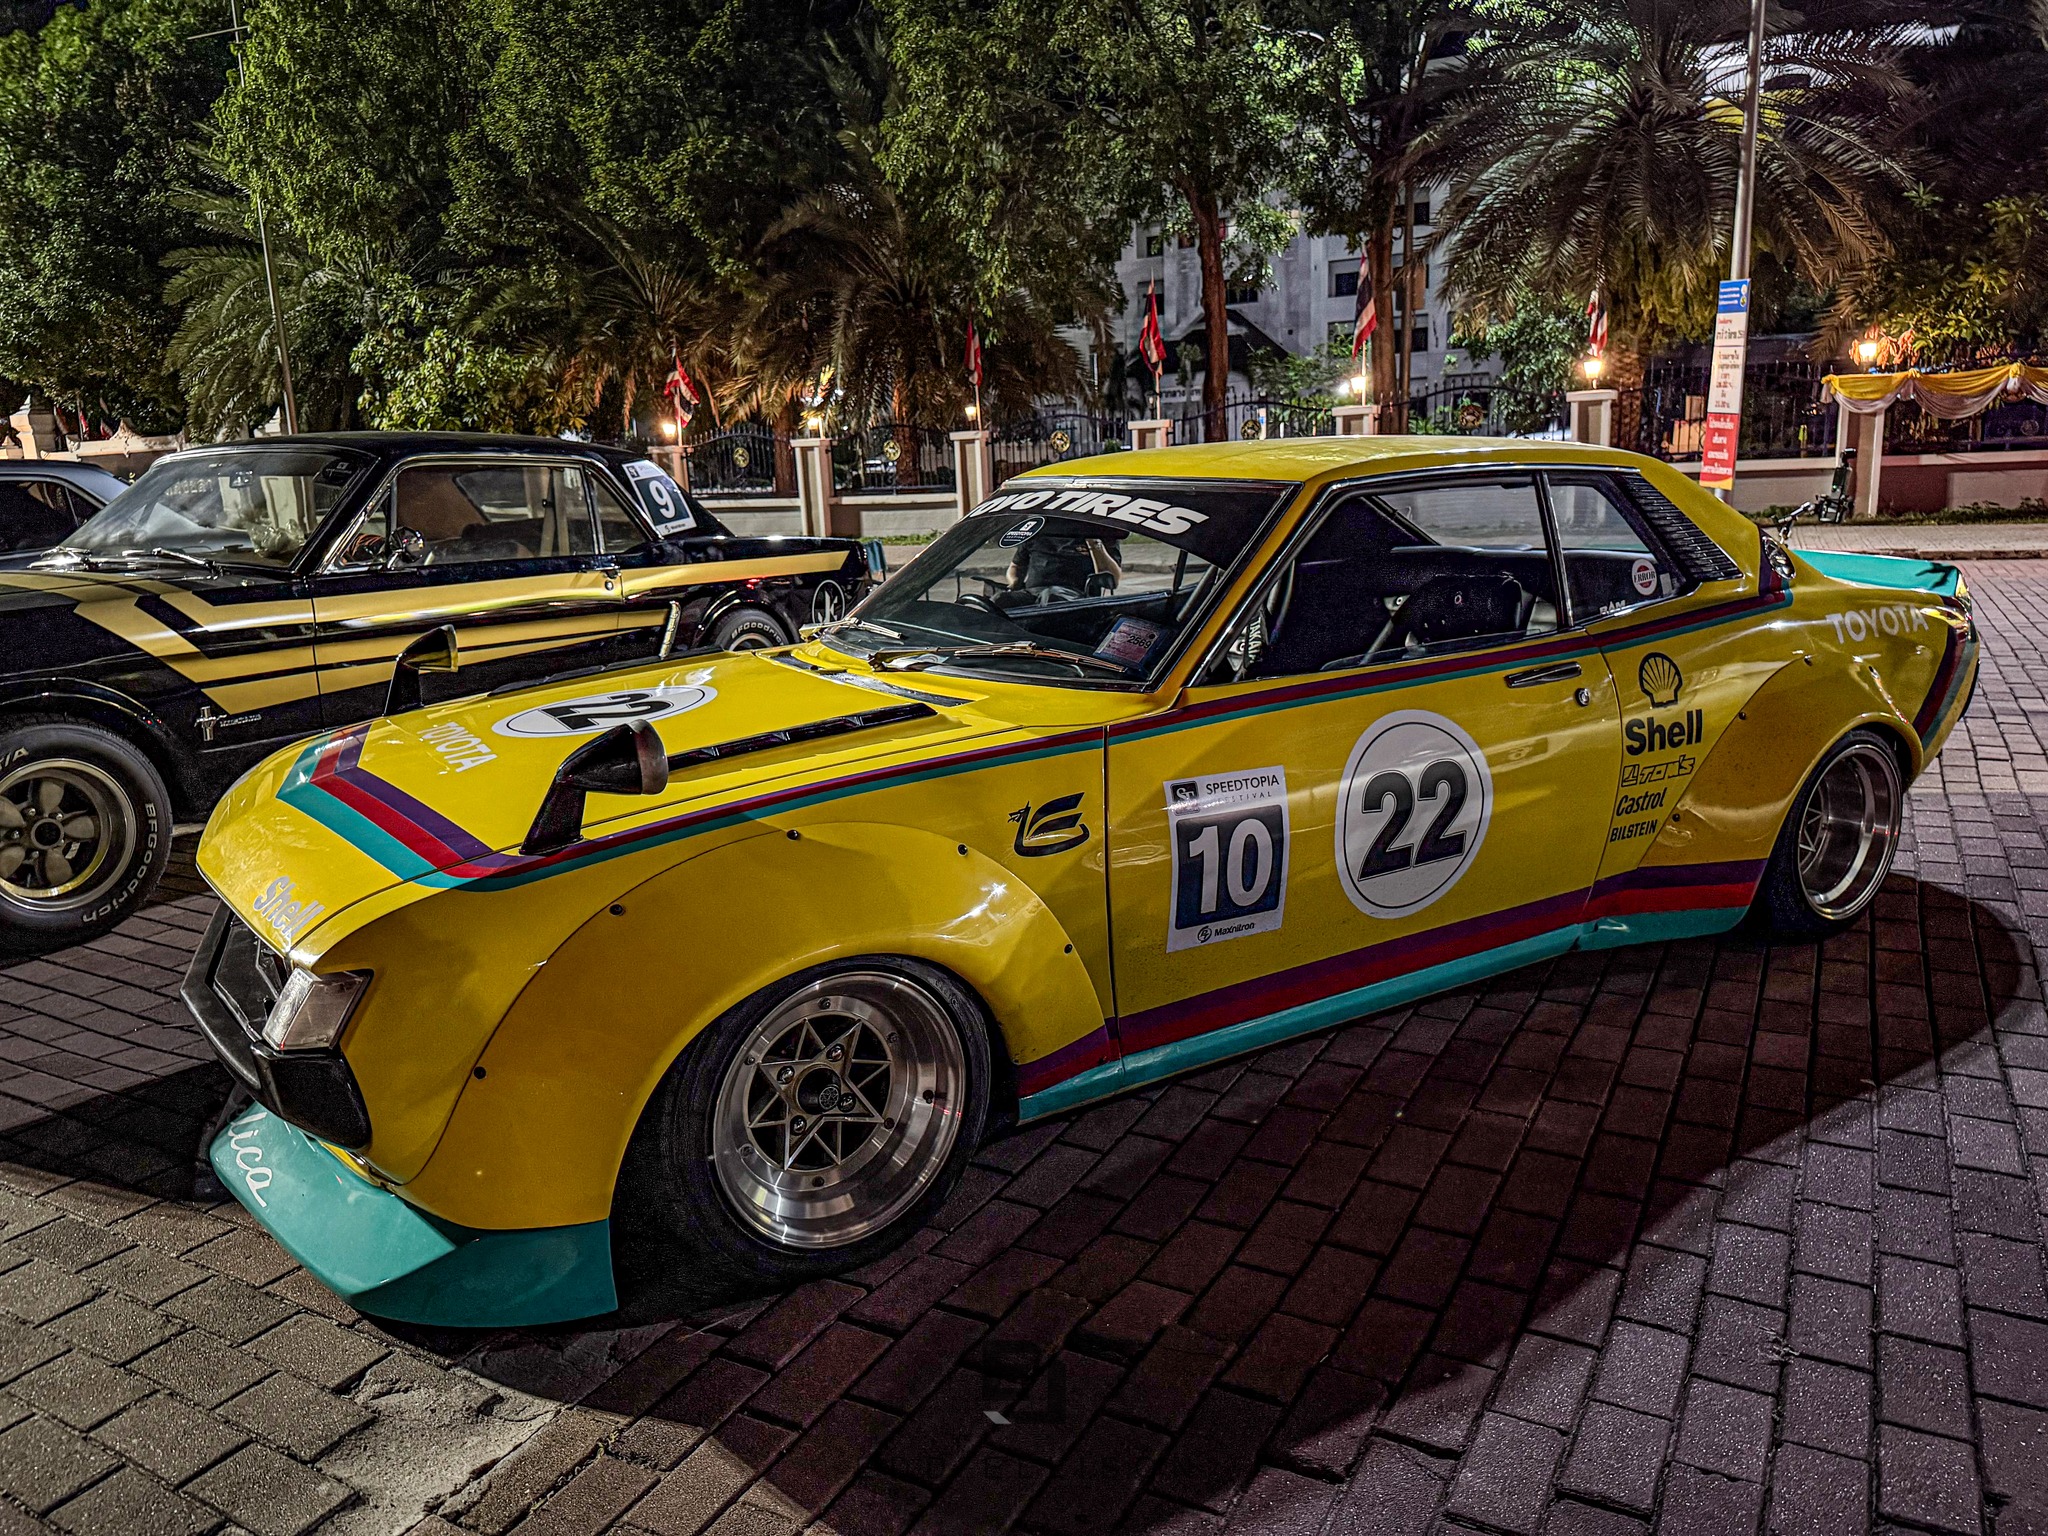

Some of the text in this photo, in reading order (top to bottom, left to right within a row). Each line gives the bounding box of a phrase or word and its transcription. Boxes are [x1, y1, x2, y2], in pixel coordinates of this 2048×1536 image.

[649, 480, 676, 519] 9
[1043, 490, 1210, 535] TIRES
[731, 621, 785, 646] BFGoodric
[1127, 634, 1152, 649] 2569
[1825, 602, 1930, 645] TOYOTA
[537, 691, 675, 731] 22
[415, 720, 498, 774] TOYOTA
[1624, 708, 1703, 757] Shell
[1205, 774, 1280, 796] SPEEDTOPIA
[1217, 790, 1272, 804] ESTIVAL
[1615, 786, 1668, 817] Castrol
[1357, 757, 1469, 883] 22
[1609, 818, 1659, 844] BILSTEIN
[82, 802, 158, 924] BFGoodrich
[1189, 817, 1273, 915] 10
[253, 875, 326, 939] Shell
[1214, 922, 1255, 937] Maxnitron
